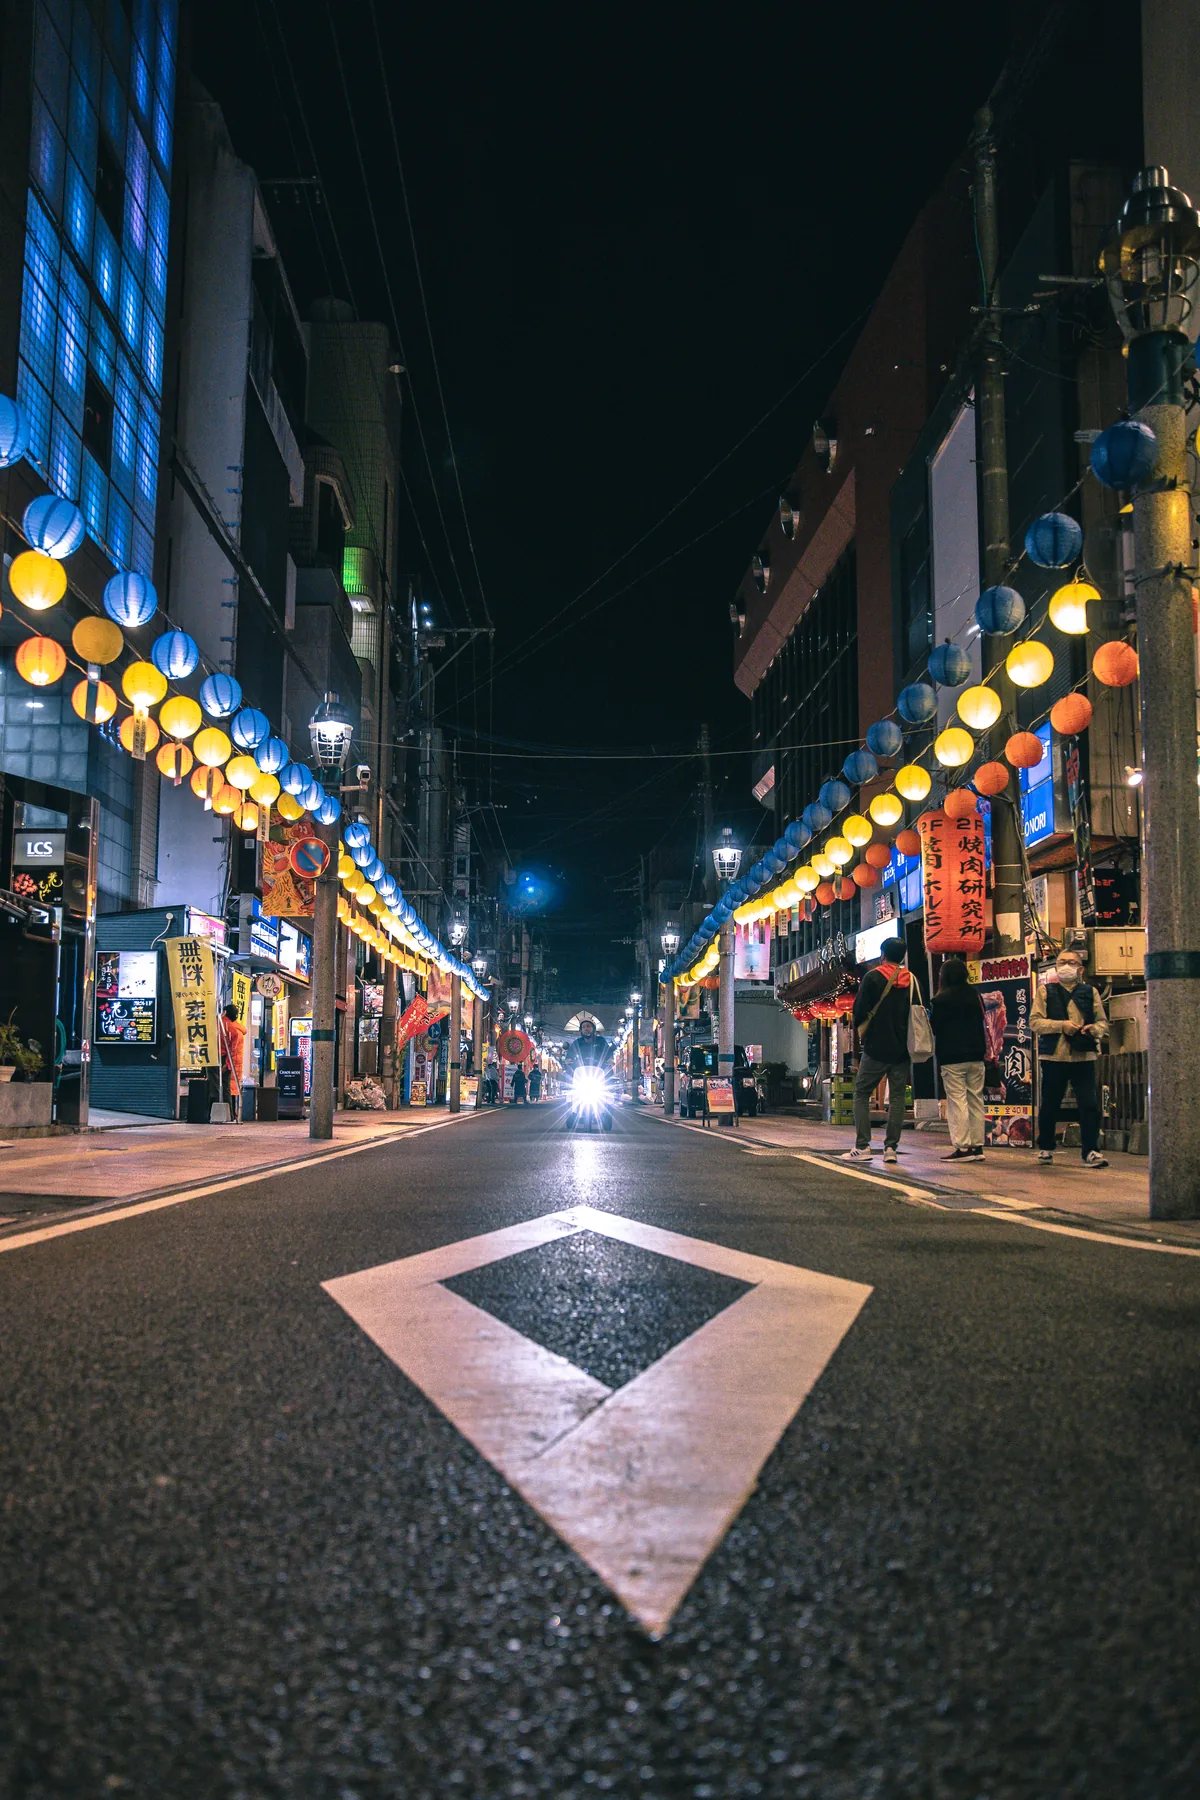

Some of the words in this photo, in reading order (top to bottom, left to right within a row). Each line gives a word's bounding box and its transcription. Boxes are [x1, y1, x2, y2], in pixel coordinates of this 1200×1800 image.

[956, 818, 983, 832] 2F
[27, 841, 53, 855] LCS
[956, 835, 984, 941] 焼肉研究所
[1004, 1045, 1026, 1081] 肉
